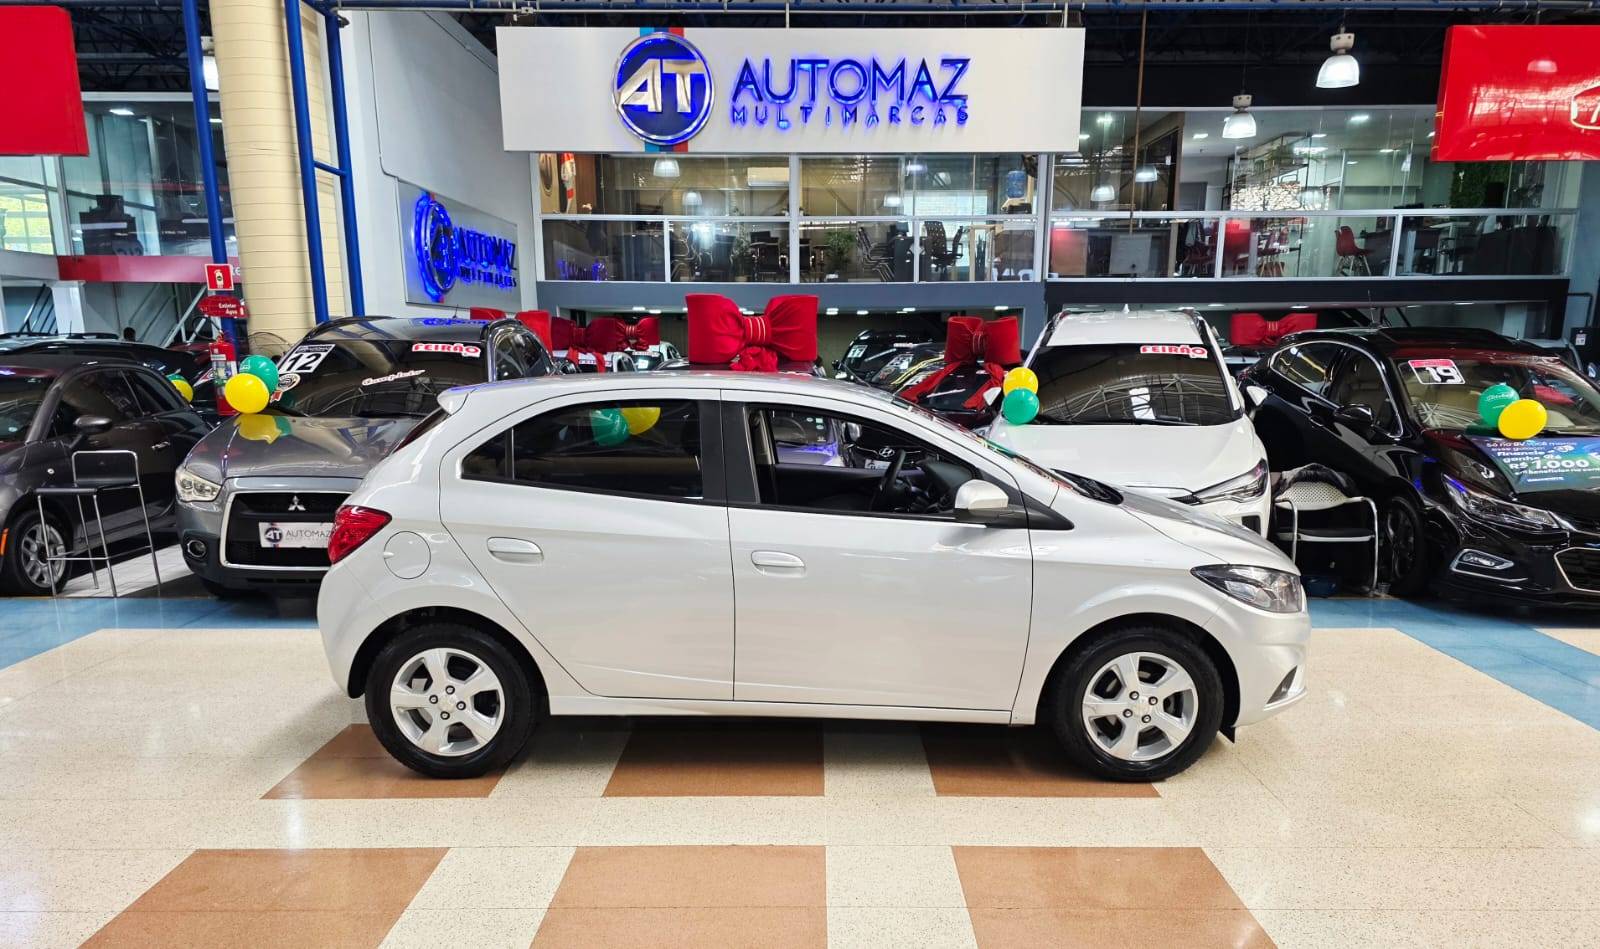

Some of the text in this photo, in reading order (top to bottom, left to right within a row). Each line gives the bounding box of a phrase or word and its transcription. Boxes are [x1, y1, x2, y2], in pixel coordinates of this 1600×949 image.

[617, 58, 705, 113] AT
[732, 57, 971, 103] AUTOMAZ
[732, 105, 969, 126] MULTIMARCAS
[454, 226, 517, 270] AUTOMAZ
[286, 353, 321, 371] 12
[1425, 366, 1461, 383] 19
[1509, 461, 1528, 470] R$
[1532, 459, 1589, 470] 1.000
[286, 529, 331, 538] AUTOMAZ
